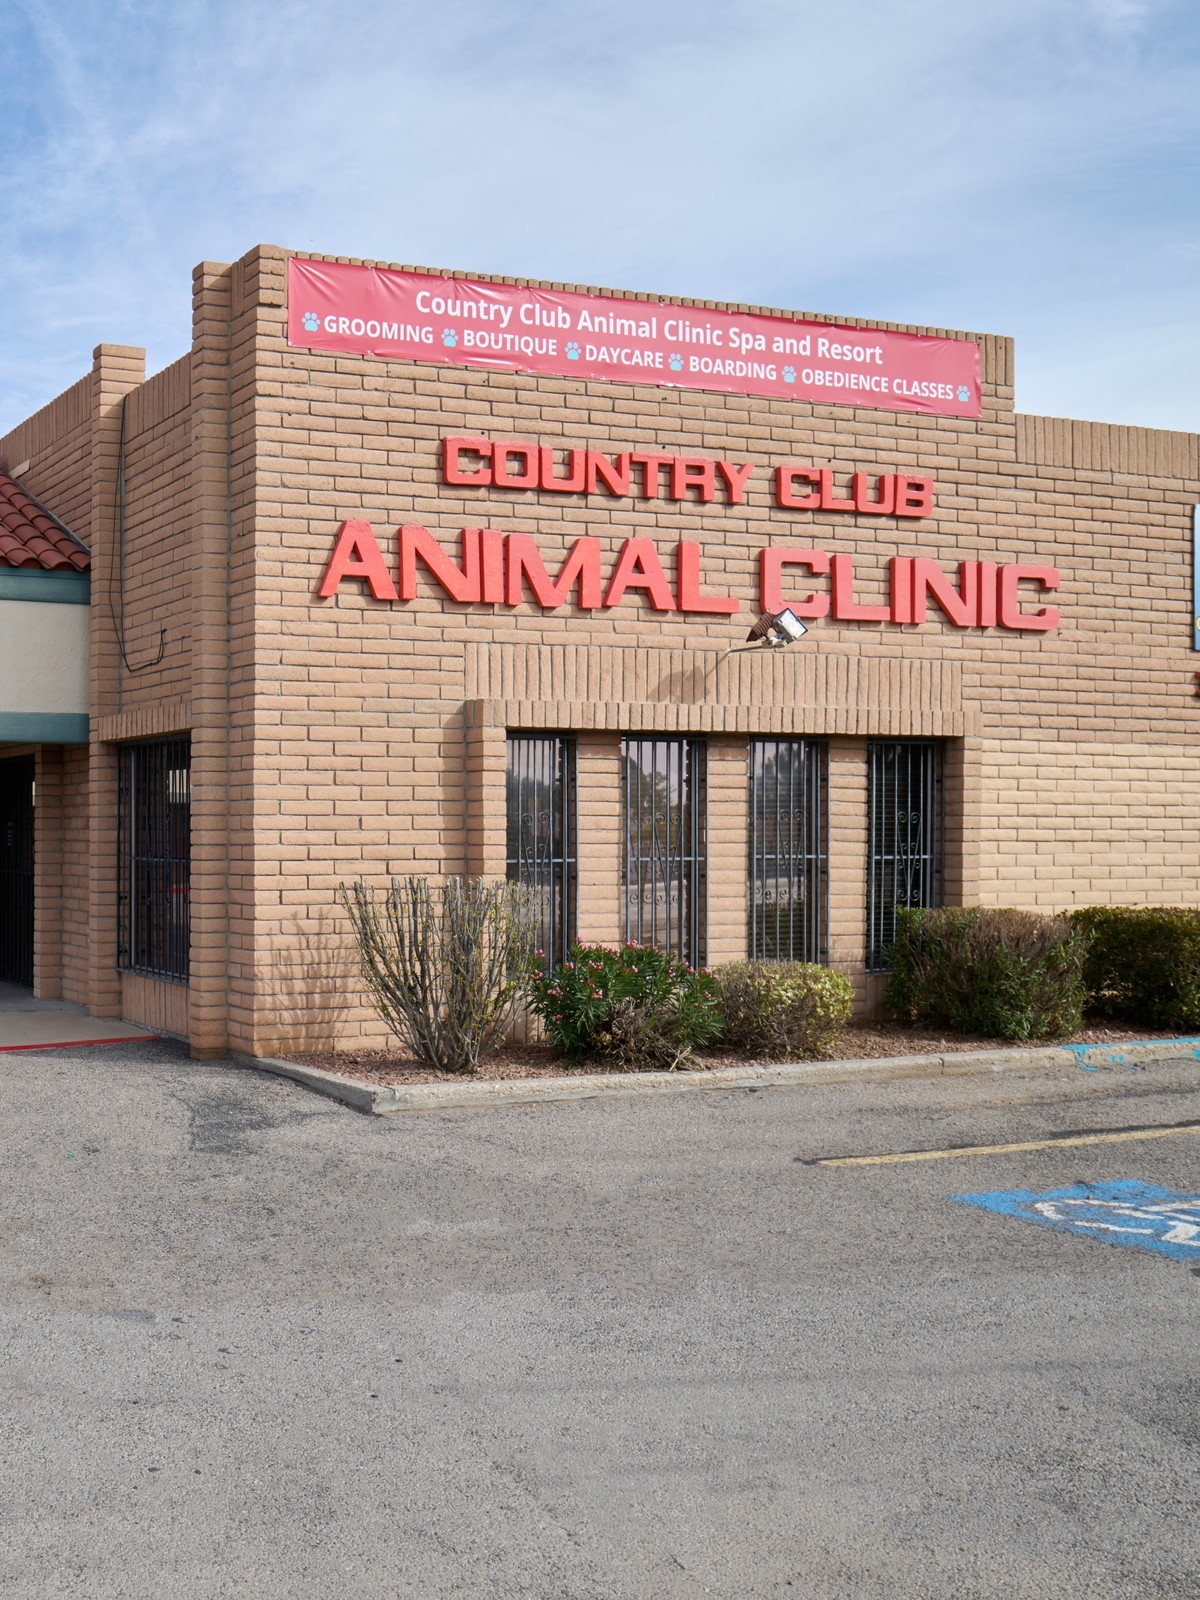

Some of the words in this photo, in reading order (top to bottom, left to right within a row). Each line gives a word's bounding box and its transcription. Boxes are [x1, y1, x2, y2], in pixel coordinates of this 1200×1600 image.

[324, 315, 434, 344] GROOMING
[463, 329, 558, 357] BOUTIQUE
[585, 344, 664, 369] DAYCARE
[689, 355, 777, 381] BOARDING
[802, 368, 889, 393] OBEDIENCE
[893, 378, 954, 400] CLASSES
[416, 290, 513, 328] Country
[519, 302, 571, 329] Club
[577, 310, 657, 339] Animal
[663, 319, 723, 346] Clinic
[728, 327, 766, 354] Spa
[772, 335, 811, 356] and
[817, 337, 883, 365] Resort
[442, 436, 755, 504] COUNTRY
[775, 465, 935, 518] CLUB
[318, 519, 740, 615] ANIMAL
[759, 547, 1062, 632] CLINIC
